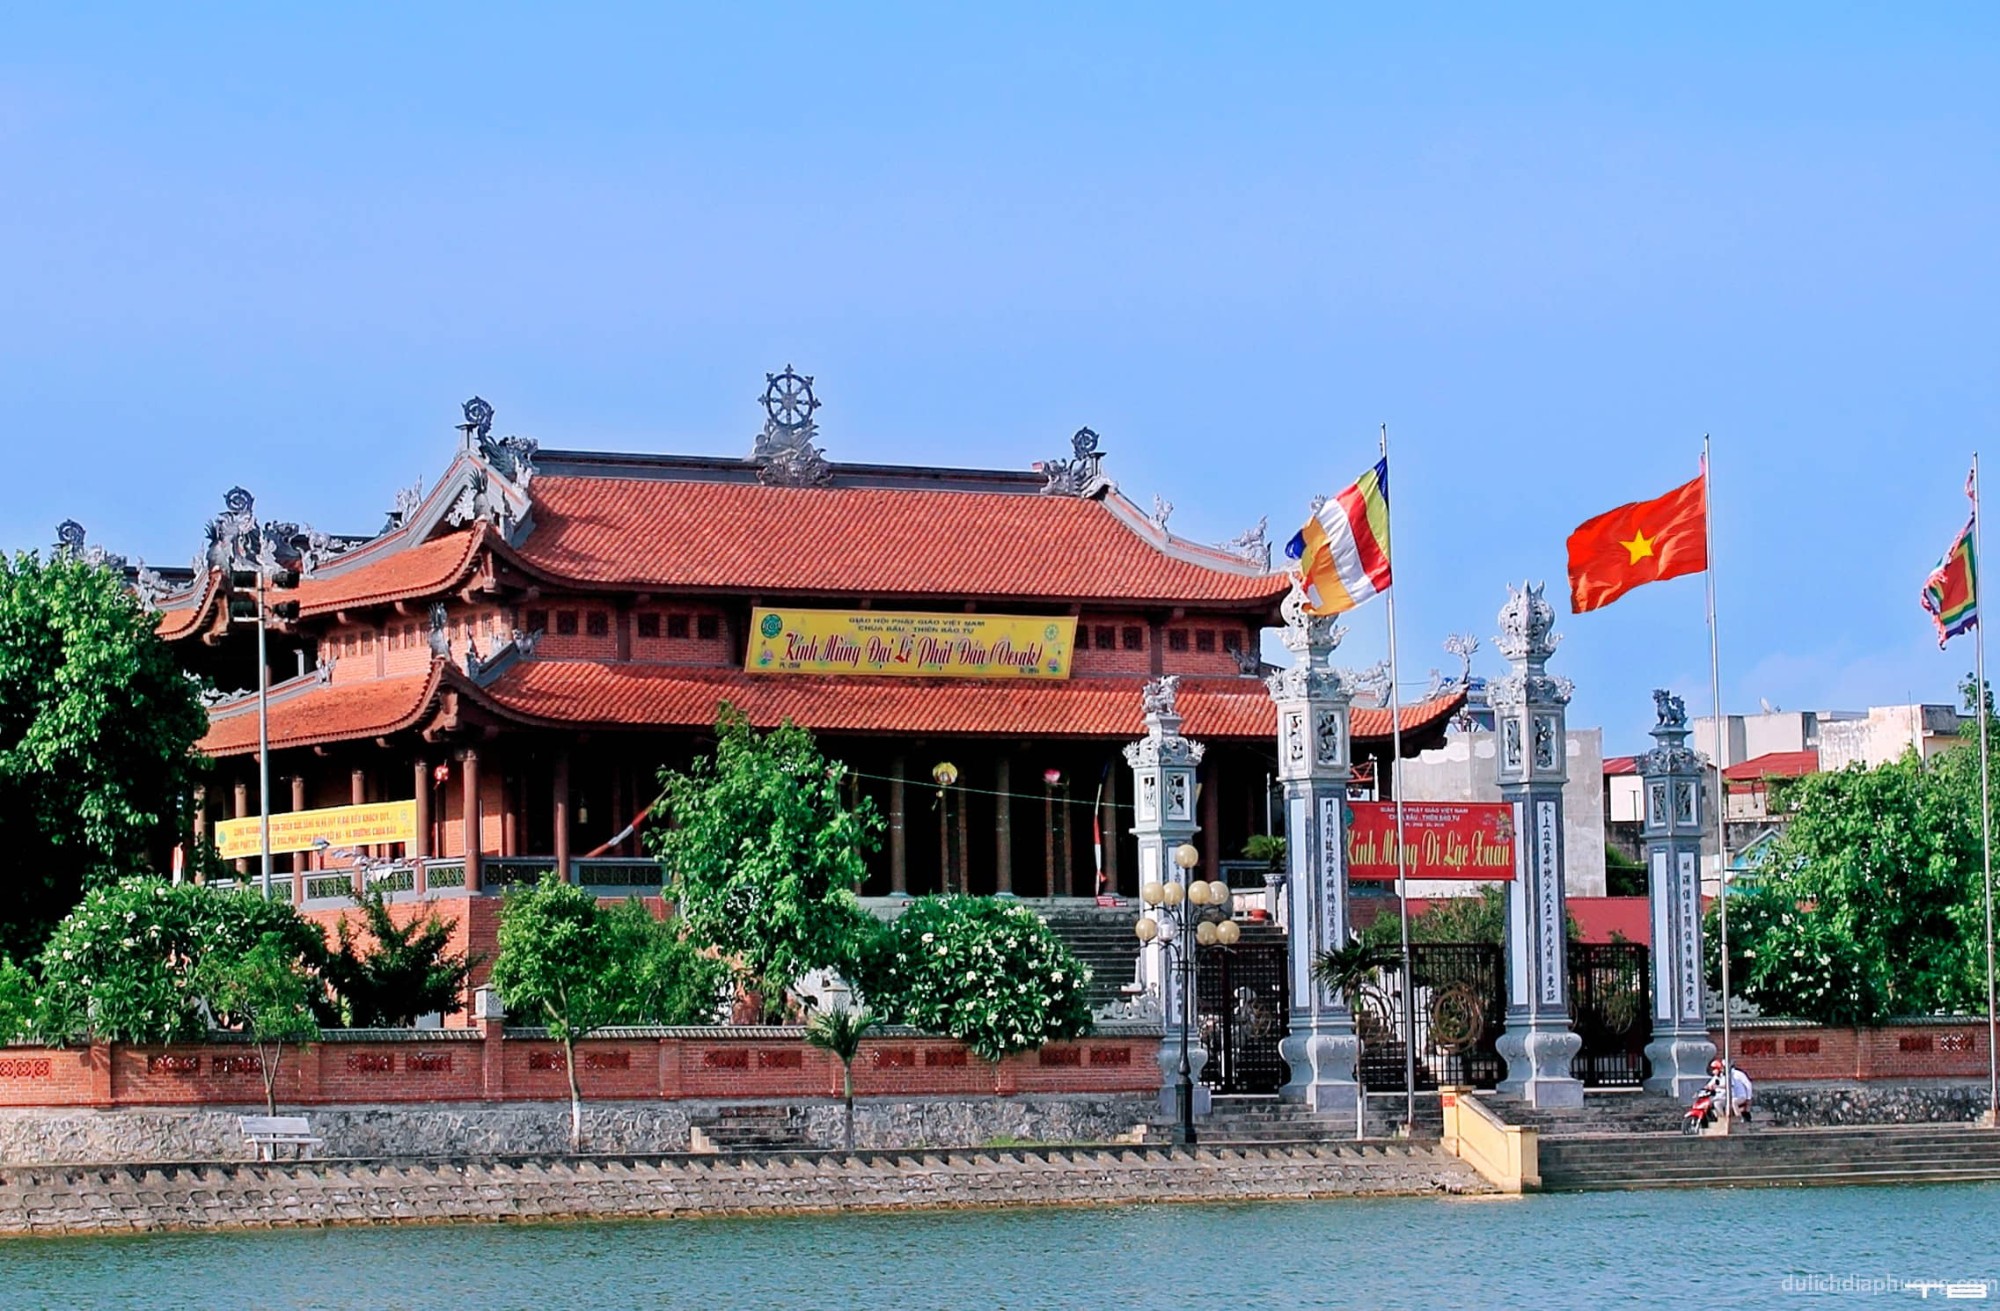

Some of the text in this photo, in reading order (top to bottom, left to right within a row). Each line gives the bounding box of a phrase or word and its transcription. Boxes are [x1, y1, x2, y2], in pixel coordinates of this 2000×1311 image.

[784, 632, 818, 662] Kính
[1346, 829, 1376, 866] Kính
[1421, 828, 1440, 866] Di
